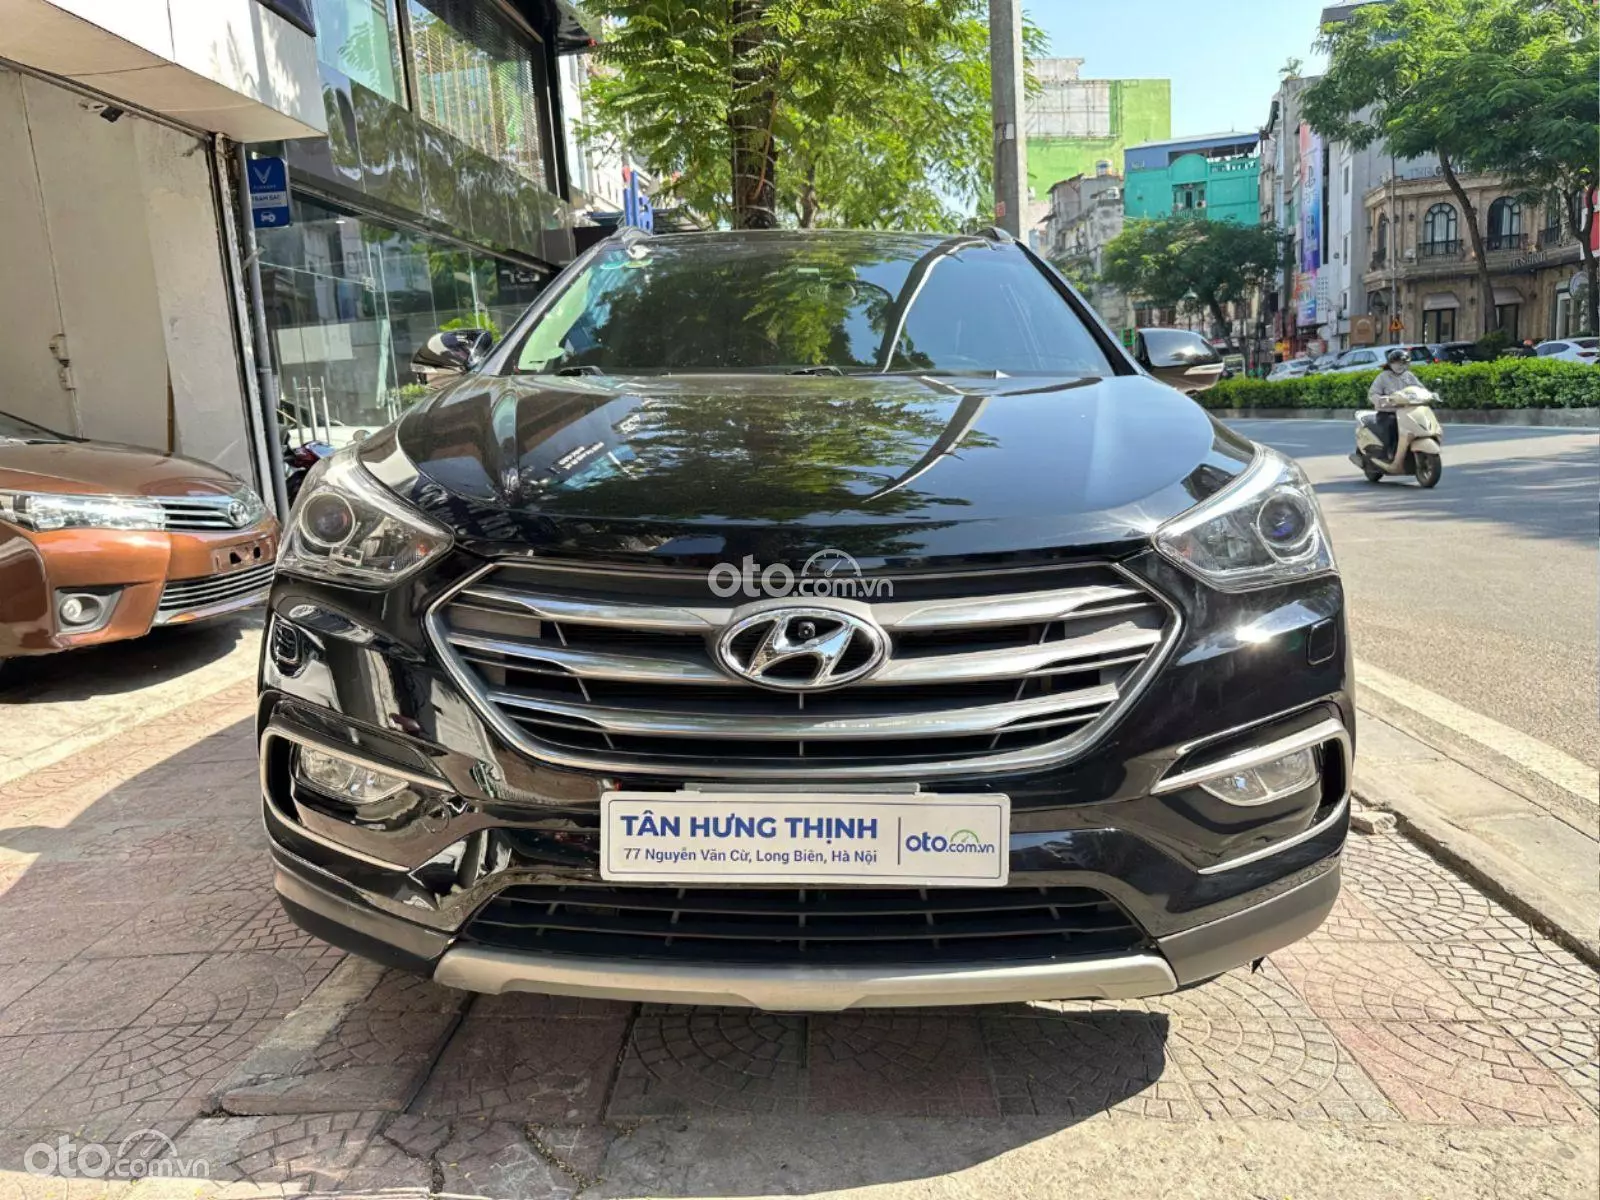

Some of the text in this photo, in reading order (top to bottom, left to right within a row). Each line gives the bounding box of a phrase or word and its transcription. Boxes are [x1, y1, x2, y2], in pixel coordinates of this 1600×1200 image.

[619, 809, 878, 845] TÂN HƯNG THỊNH
[905, 831, 995, 853] oto.com.vn
[623, 846, 877, 866] 77 Nguyễn Văn Cừ, Long Biên, Hà Nội
